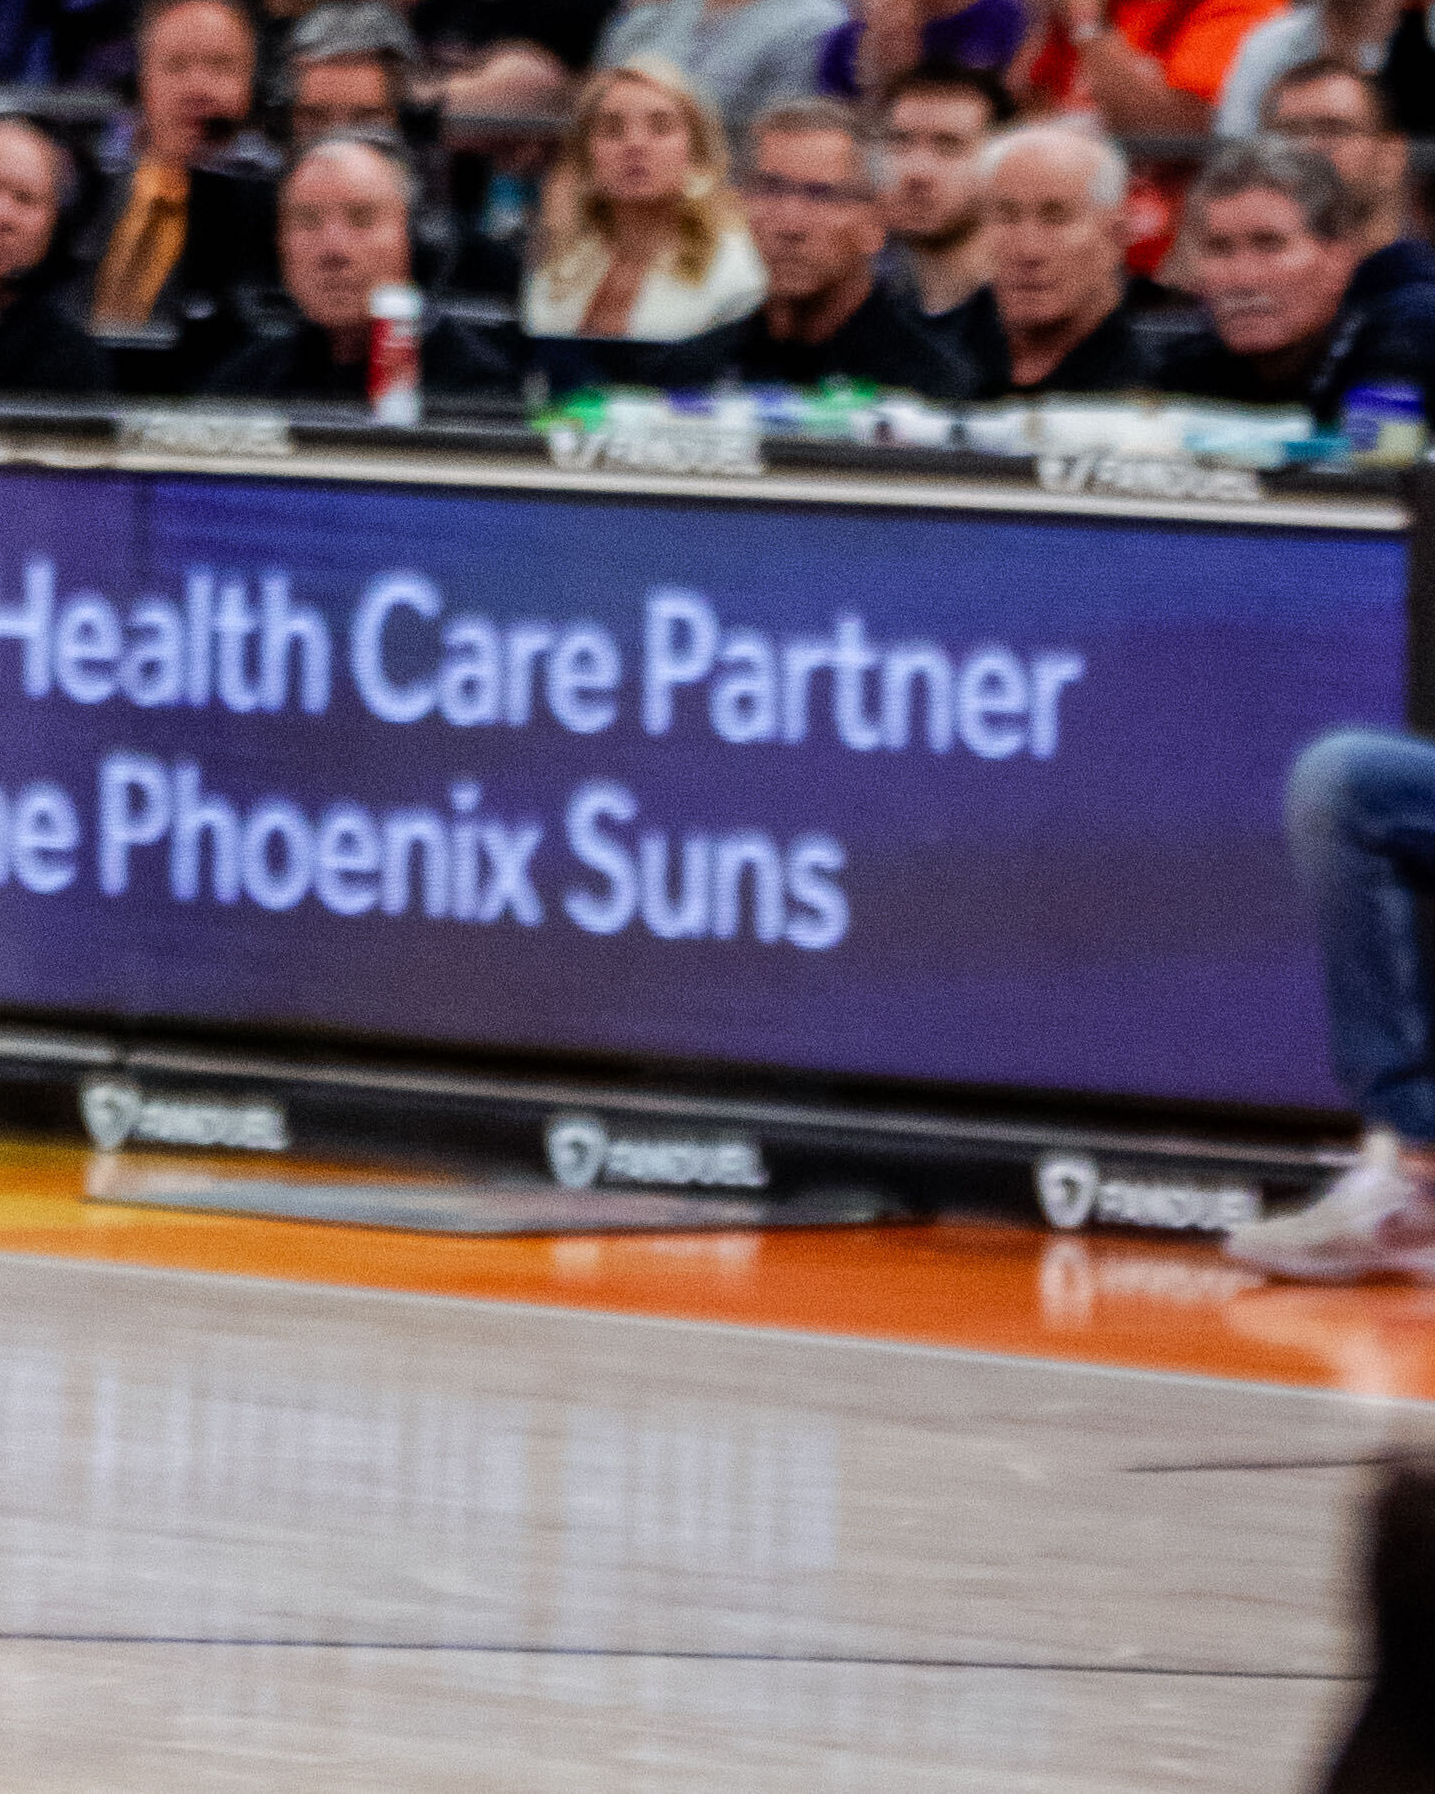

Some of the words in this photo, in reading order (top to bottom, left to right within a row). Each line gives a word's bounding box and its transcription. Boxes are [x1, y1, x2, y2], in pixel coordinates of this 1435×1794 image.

[350, 571, 624, 735] Care
[643, 585, 1086, 761] Partner
[98, 749, 544, 927] Phoenix
[566, 779, 850, 949] Suns
